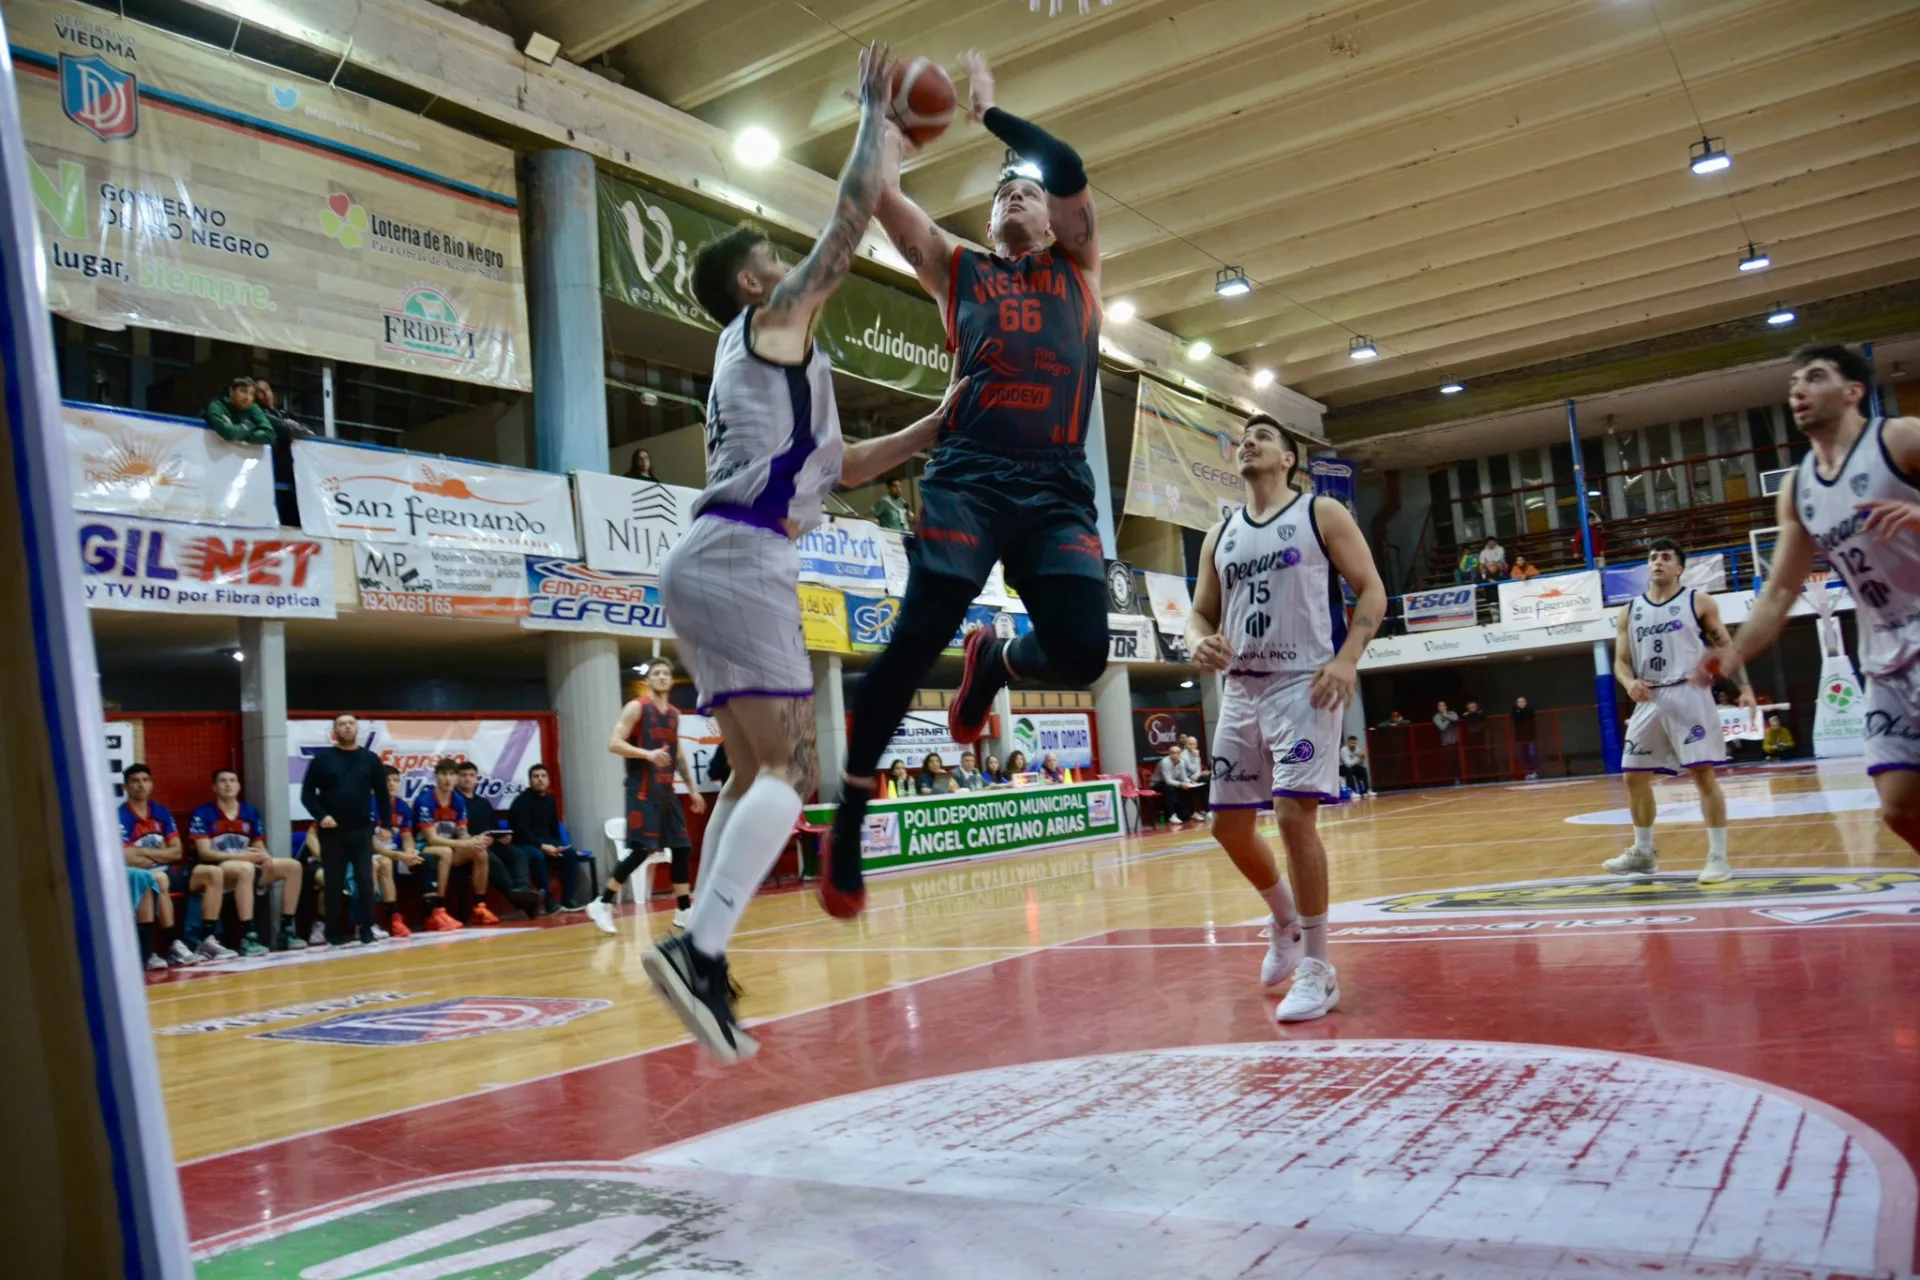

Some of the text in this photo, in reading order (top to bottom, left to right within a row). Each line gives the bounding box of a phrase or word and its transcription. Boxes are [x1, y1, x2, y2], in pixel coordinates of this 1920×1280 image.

[54, 22, 137, 62] VIEDMA
[192, 228, 270, 260] NEGRO
[424, 228, 440, 252] de
[467, 240, 504, 268] Negro
[53, 242, 278, 311] lugar, siempre.
[972, 270, 1067, 304] VIEDMA
[1000, 298, 1042, 332] 66
[383, 315, 476, 360] FRIDEVI
[1034, 361, 1071, 377] Negro
[988, 389, 1045, 405] FRIDEVI
[1191, 462, 1246, 491] CEFERI
[78, 523, 322, 588] GIL NET
[605, 518, 682, 567] NIJA
[365, 552, 406, 577] MP
[1838, 546, 1873, 576] 12
[86, 585, 97, 599] y
[104, 583, 133, 598] TV
[140, 585, 170, 600] HD
[177, 591, 209, 604] por
[216, 589, 260, 605] Fibra
[541, 580, 643, 602] EMPRESA
[1247, 580, 1270, 605] 15
[1408, 589, 1471, 611] ESCO
[1269, 650, 1297, 661] PICO
[1424, 638, 1460, 652] Viedma
[1483, 631, 1520, 645] Viedma
[1653, 640, 1663, 653] 8
[1040, 729, 1088, 750] DON OMAR
[904, 793, 1086, 829] POLIDEPORTIVO MUNICIPAL
[908, 827, 964, 856] ÁNGEL
[966, 819, 1043, 849] CAYETANO
[1045, 813, 1086, 837] ARIAS
